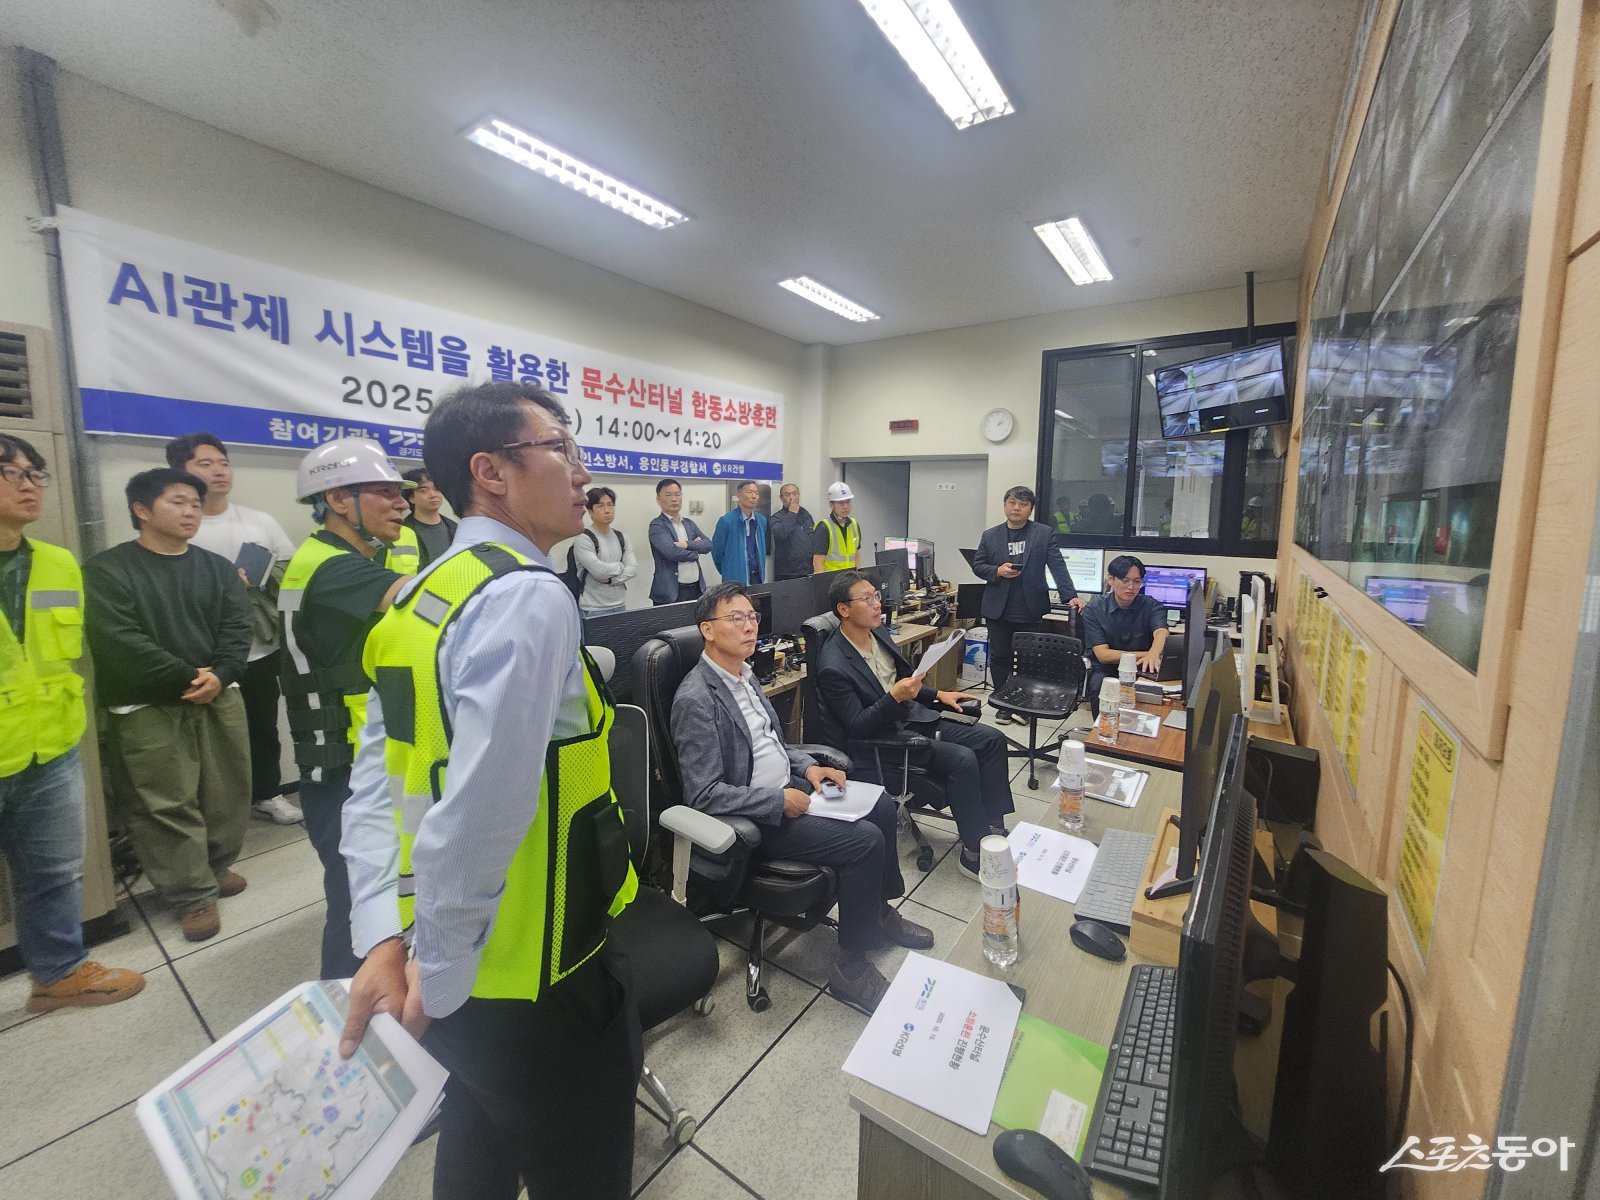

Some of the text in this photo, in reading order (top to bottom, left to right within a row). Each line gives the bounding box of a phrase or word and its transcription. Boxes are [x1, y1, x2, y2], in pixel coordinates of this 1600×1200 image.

[108, 262, 777, 429] AI관제 시스템을 활용한 문수산터널 합동소방훈련
[341, 376, 433, 414] 2025
[596, 415, 721, 449] 14:00~14:20
[580, 449, 634, 471] 인소방서,
[639, 456, 707, 475] 용인동부경찰서
[722, 462, 745, 475] KR건설
[969, 1024, 990, 1063] 문수산터널
